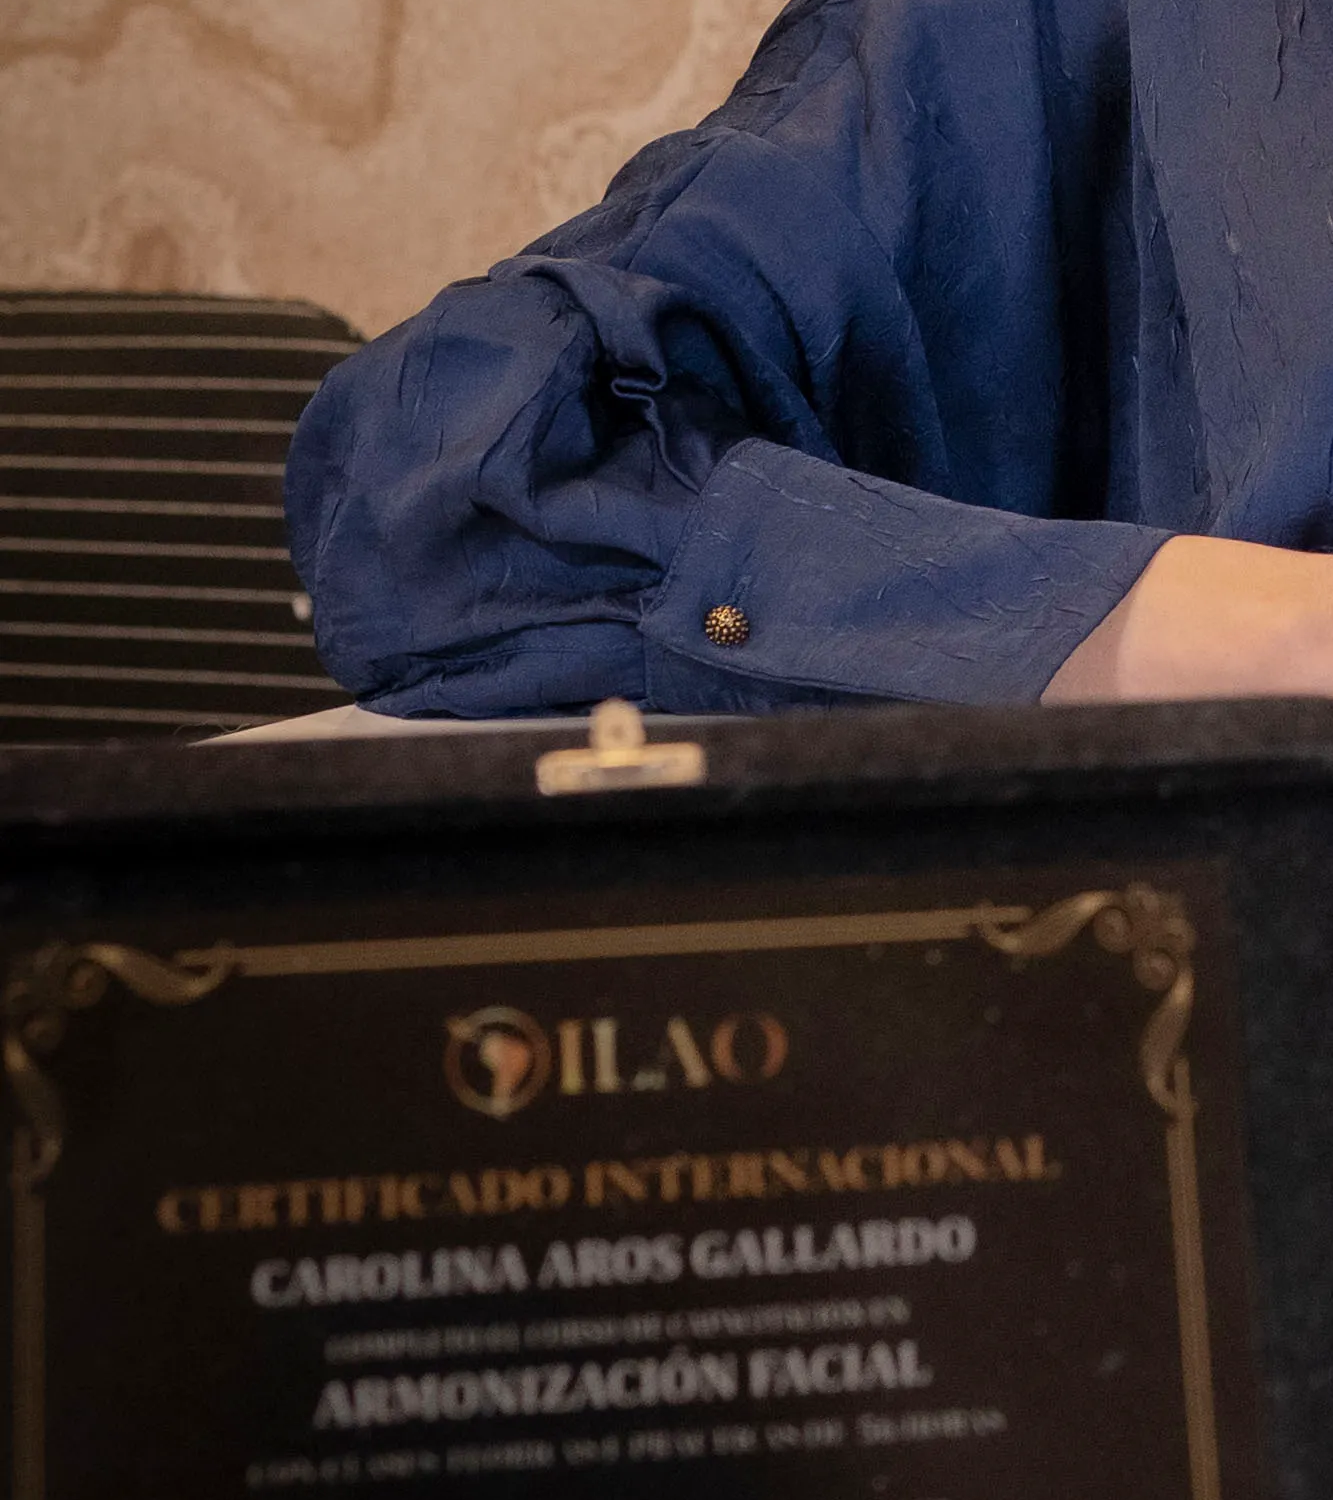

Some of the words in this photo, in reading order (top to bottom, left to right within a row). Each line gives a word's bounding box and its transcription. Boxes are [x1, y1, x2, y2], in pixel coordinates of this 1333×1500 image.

[155, 1161, 576, 1233] CERTIFICADO
[584, 1132, 1064, 1209] INTERNACIONAL
[248, 1242, 533, 1313] CAROLINA
[535, 1232, 684, 1292] AROS
[687, 1212, 979, 1281] GALLARDO
[309, 1343, 741, 1433] ARMONIZACIÓN
[746, 1337, 936, 1401] FACIAL
